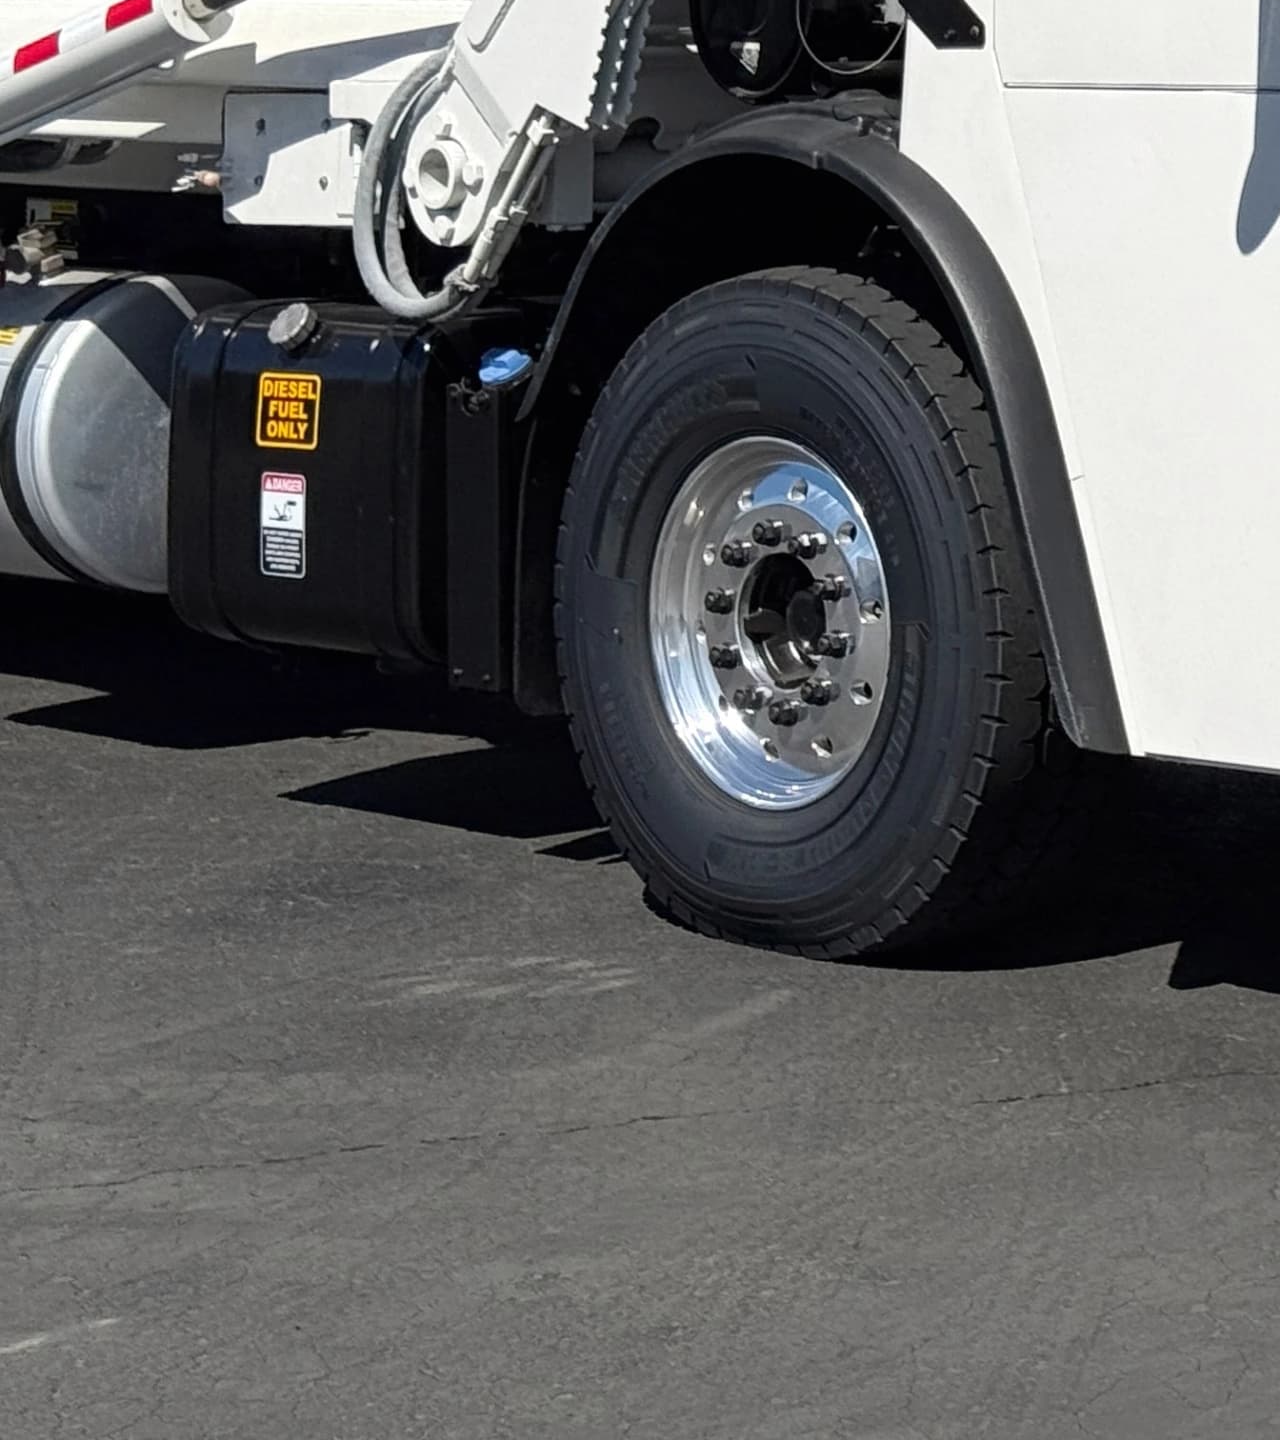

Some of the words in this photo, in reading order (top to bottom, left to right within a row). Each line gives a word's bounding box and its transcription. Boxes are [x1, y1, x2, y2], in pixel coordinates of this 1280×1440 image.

[263, 379, 317, 399] DIESEL
[268, 400, 308, 419] FUEL
[266, 420, 308, 440] ONLY
